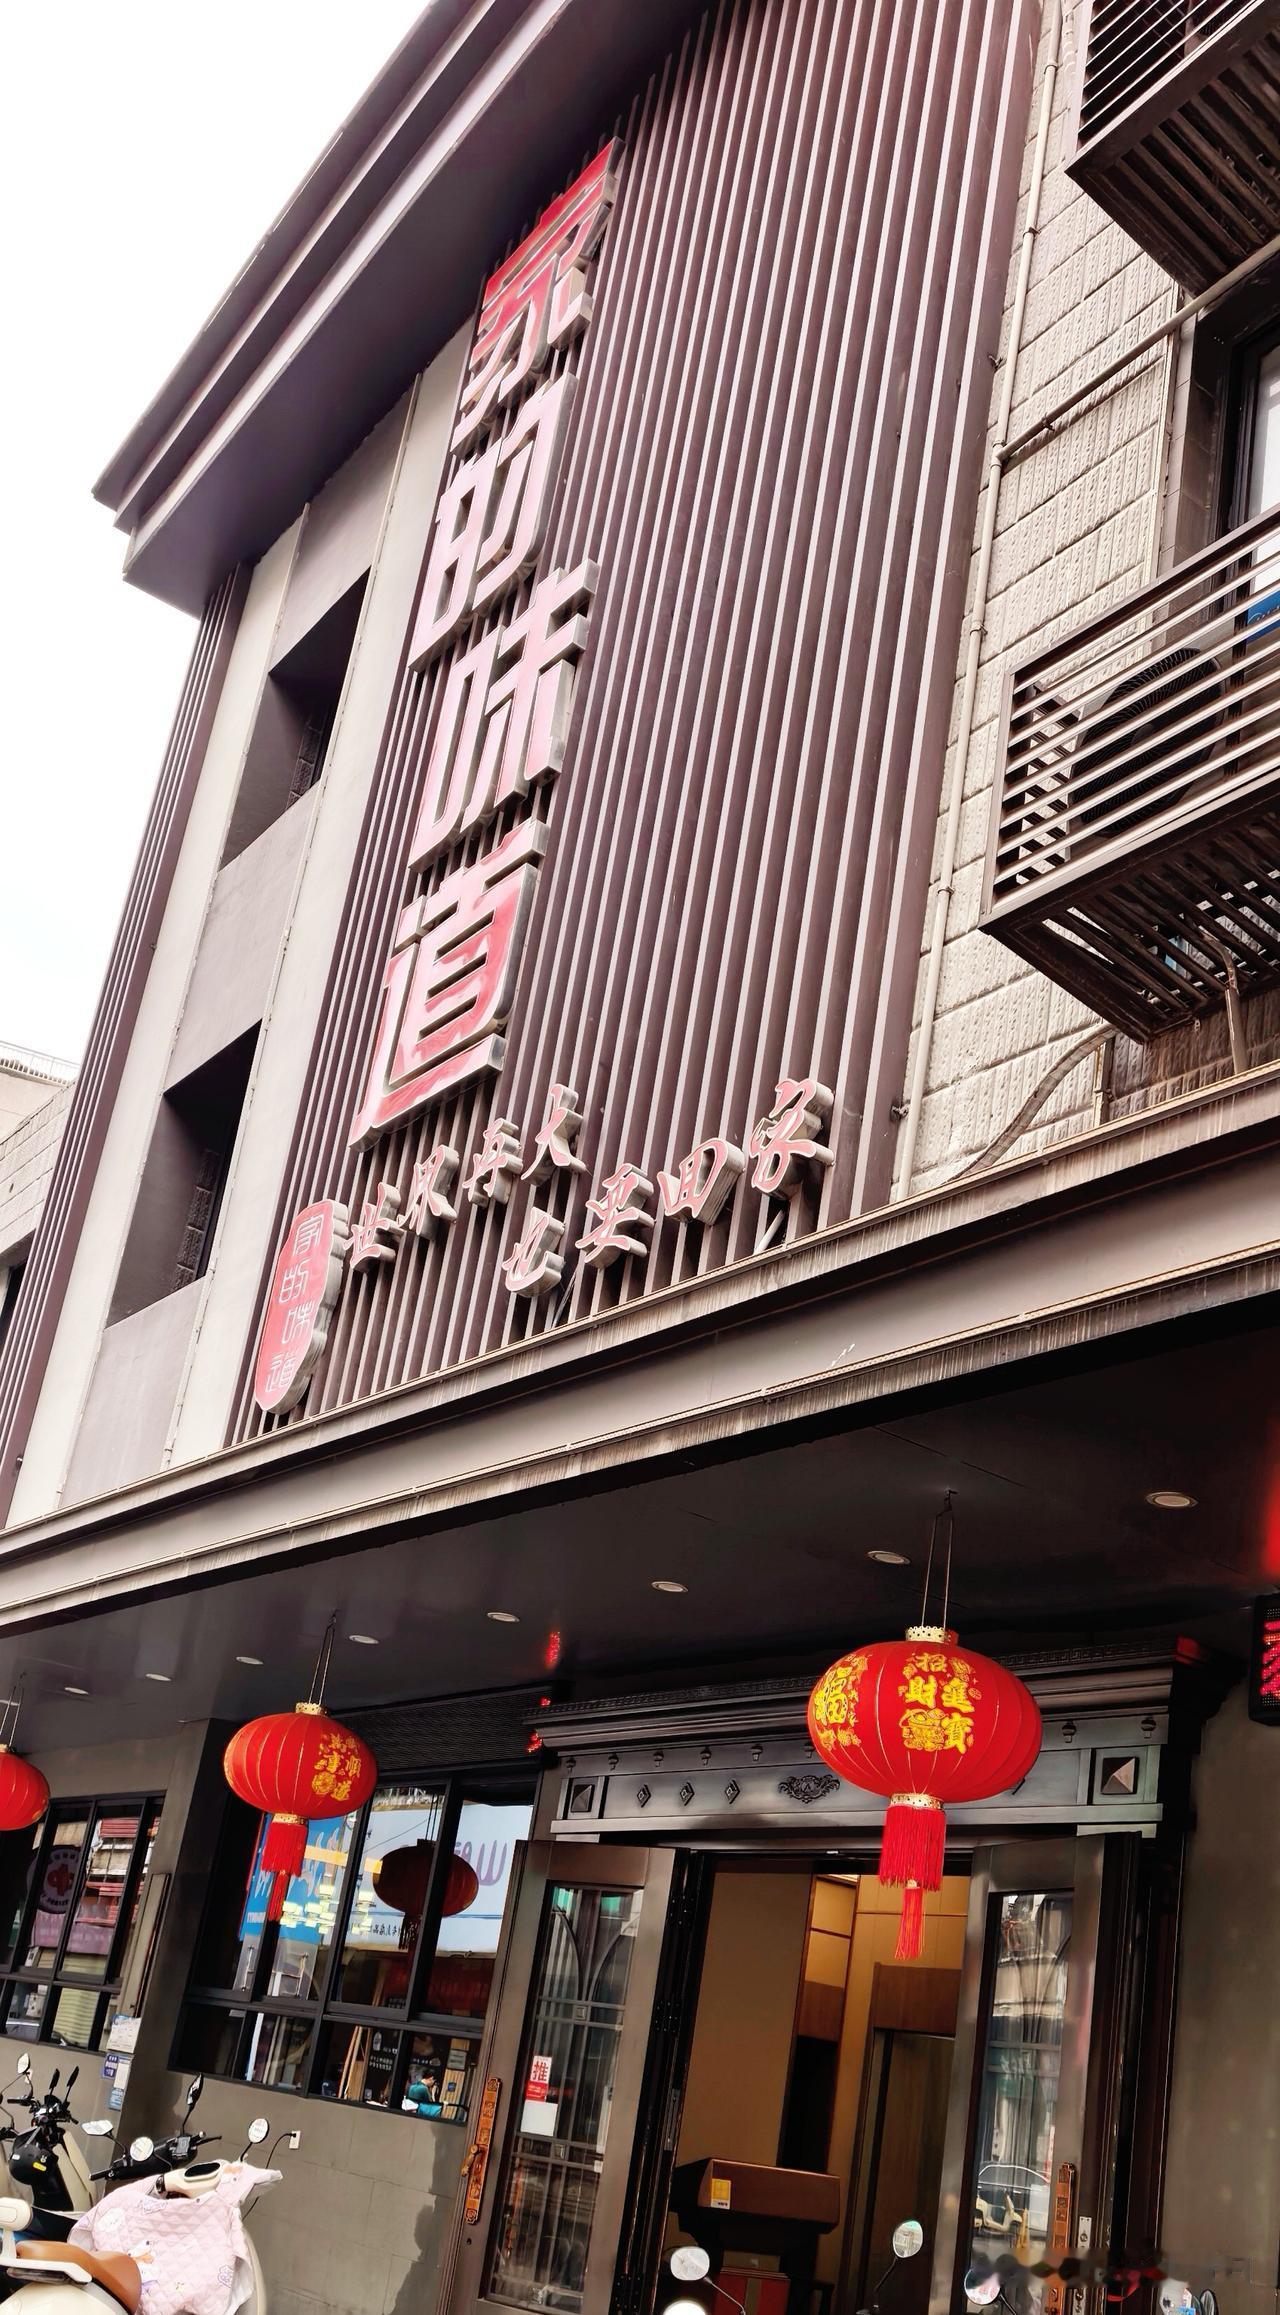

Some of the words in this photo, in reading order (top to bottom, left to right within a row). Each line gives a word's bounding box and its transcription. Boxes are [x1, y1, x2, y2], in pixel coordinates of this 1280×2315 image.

[349, 138, 617, 1148] 家的味道
[343, 1083, 576, 1270] 世界再大
[502, 1078, 824, 1292] 也要回家
[532, 2060, 549, 2082] 推
